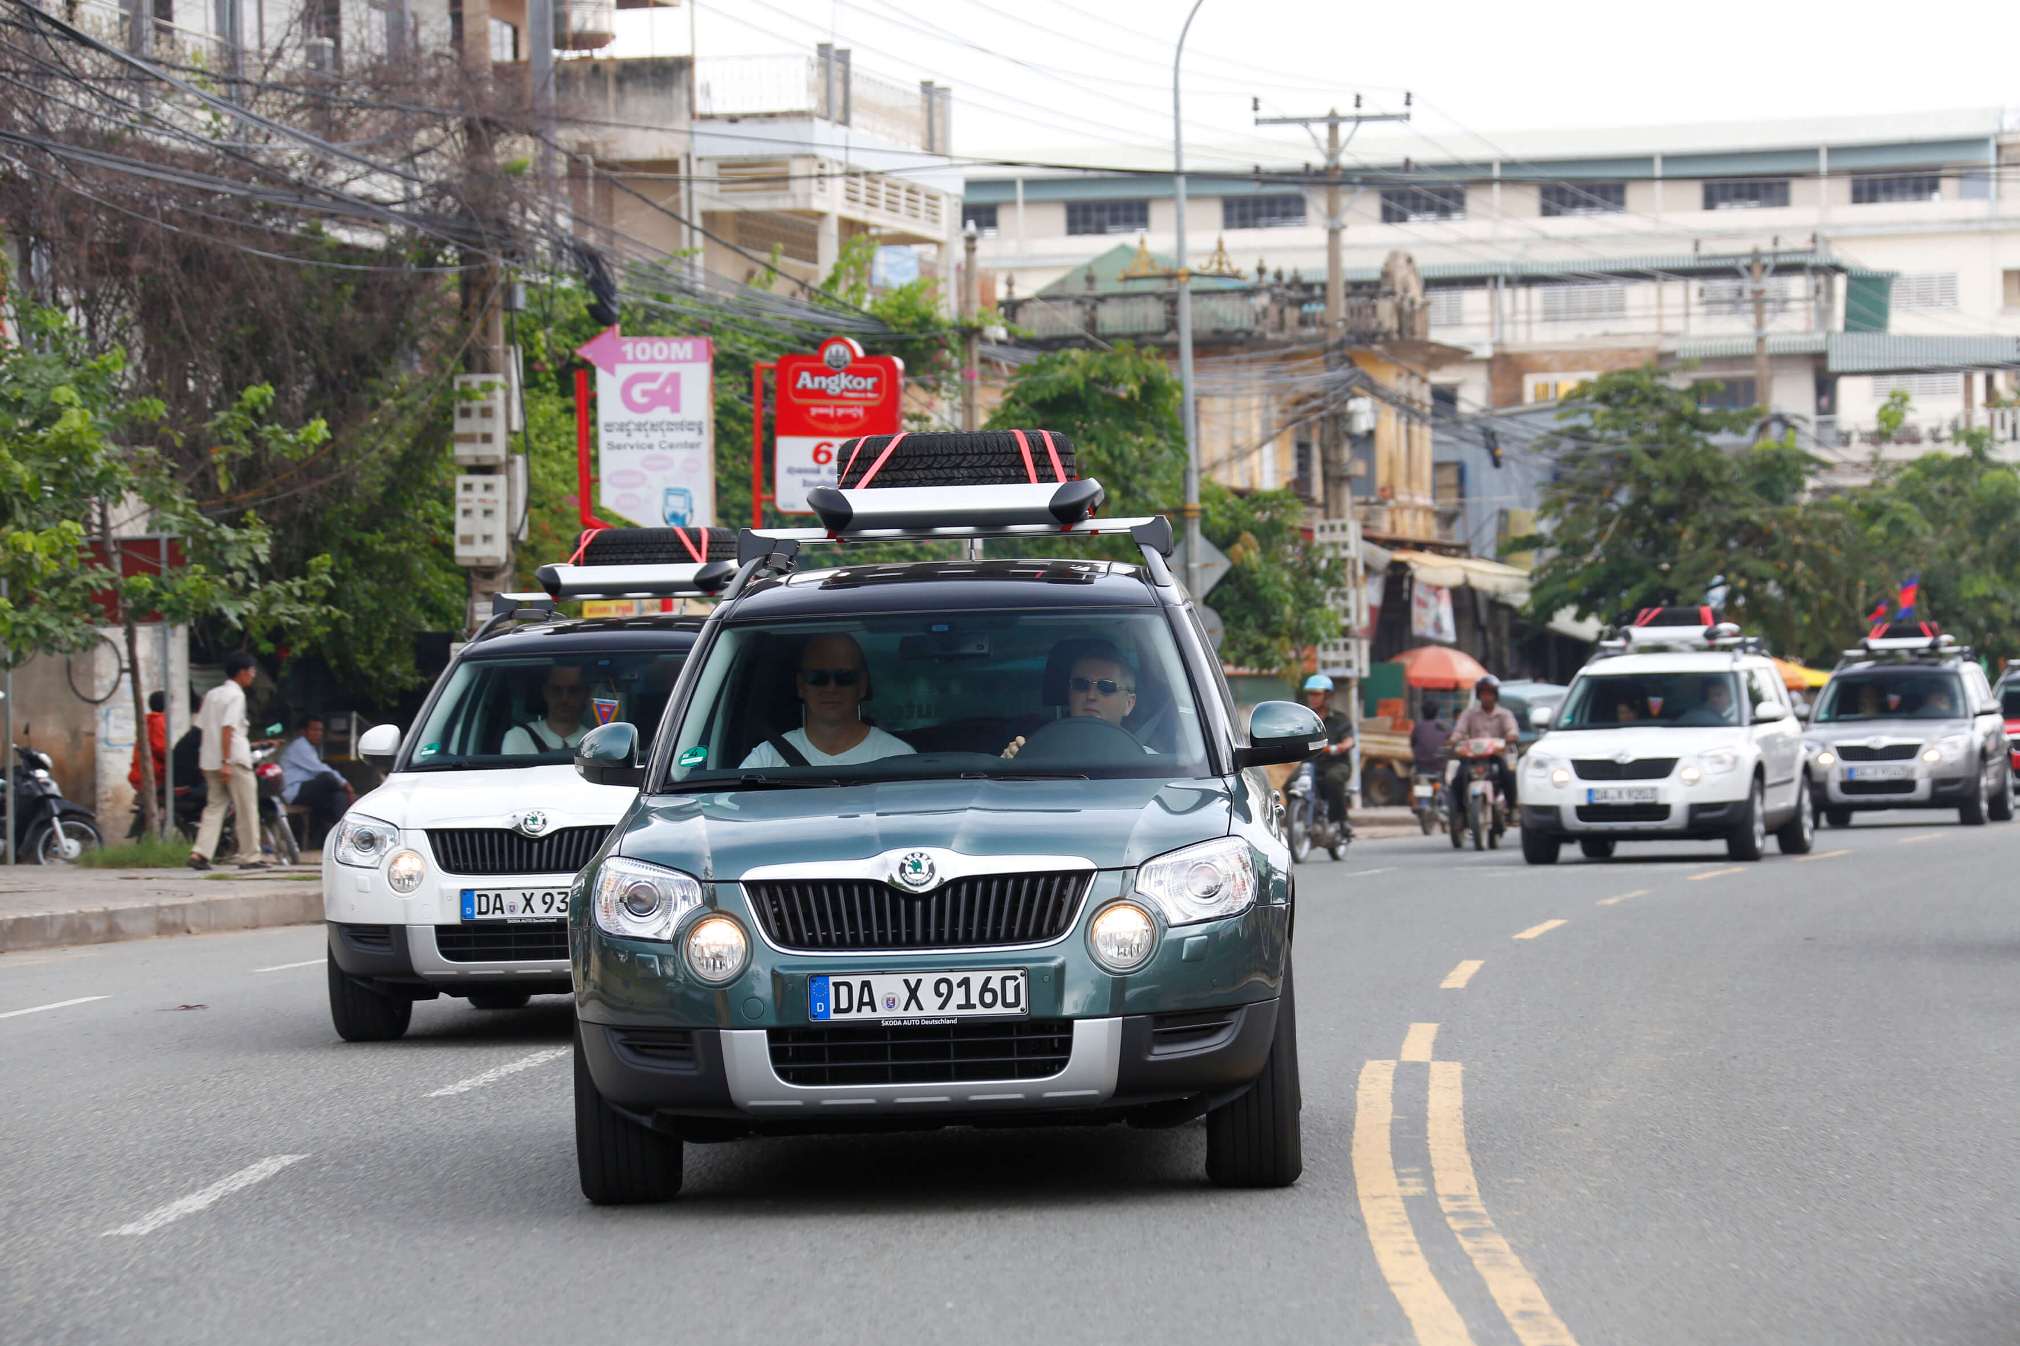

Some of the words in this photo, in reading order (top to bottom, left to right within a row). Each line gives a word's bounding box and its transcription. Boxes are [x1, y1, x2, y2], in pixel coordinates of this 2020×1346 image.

[621, 341, 693, 361] 100M
[607, 440, 655, 451] Service
[658, 439, 702, 450] Center
[477, 894, 504, 915] DA
[521, 892, 536, 914] X
[832, 979, 878, 1014] DA
[903, 978, 925, 1012] X
[933, 974, 1021, 1010] 9160
[816, 1002, 825, 1013] D
